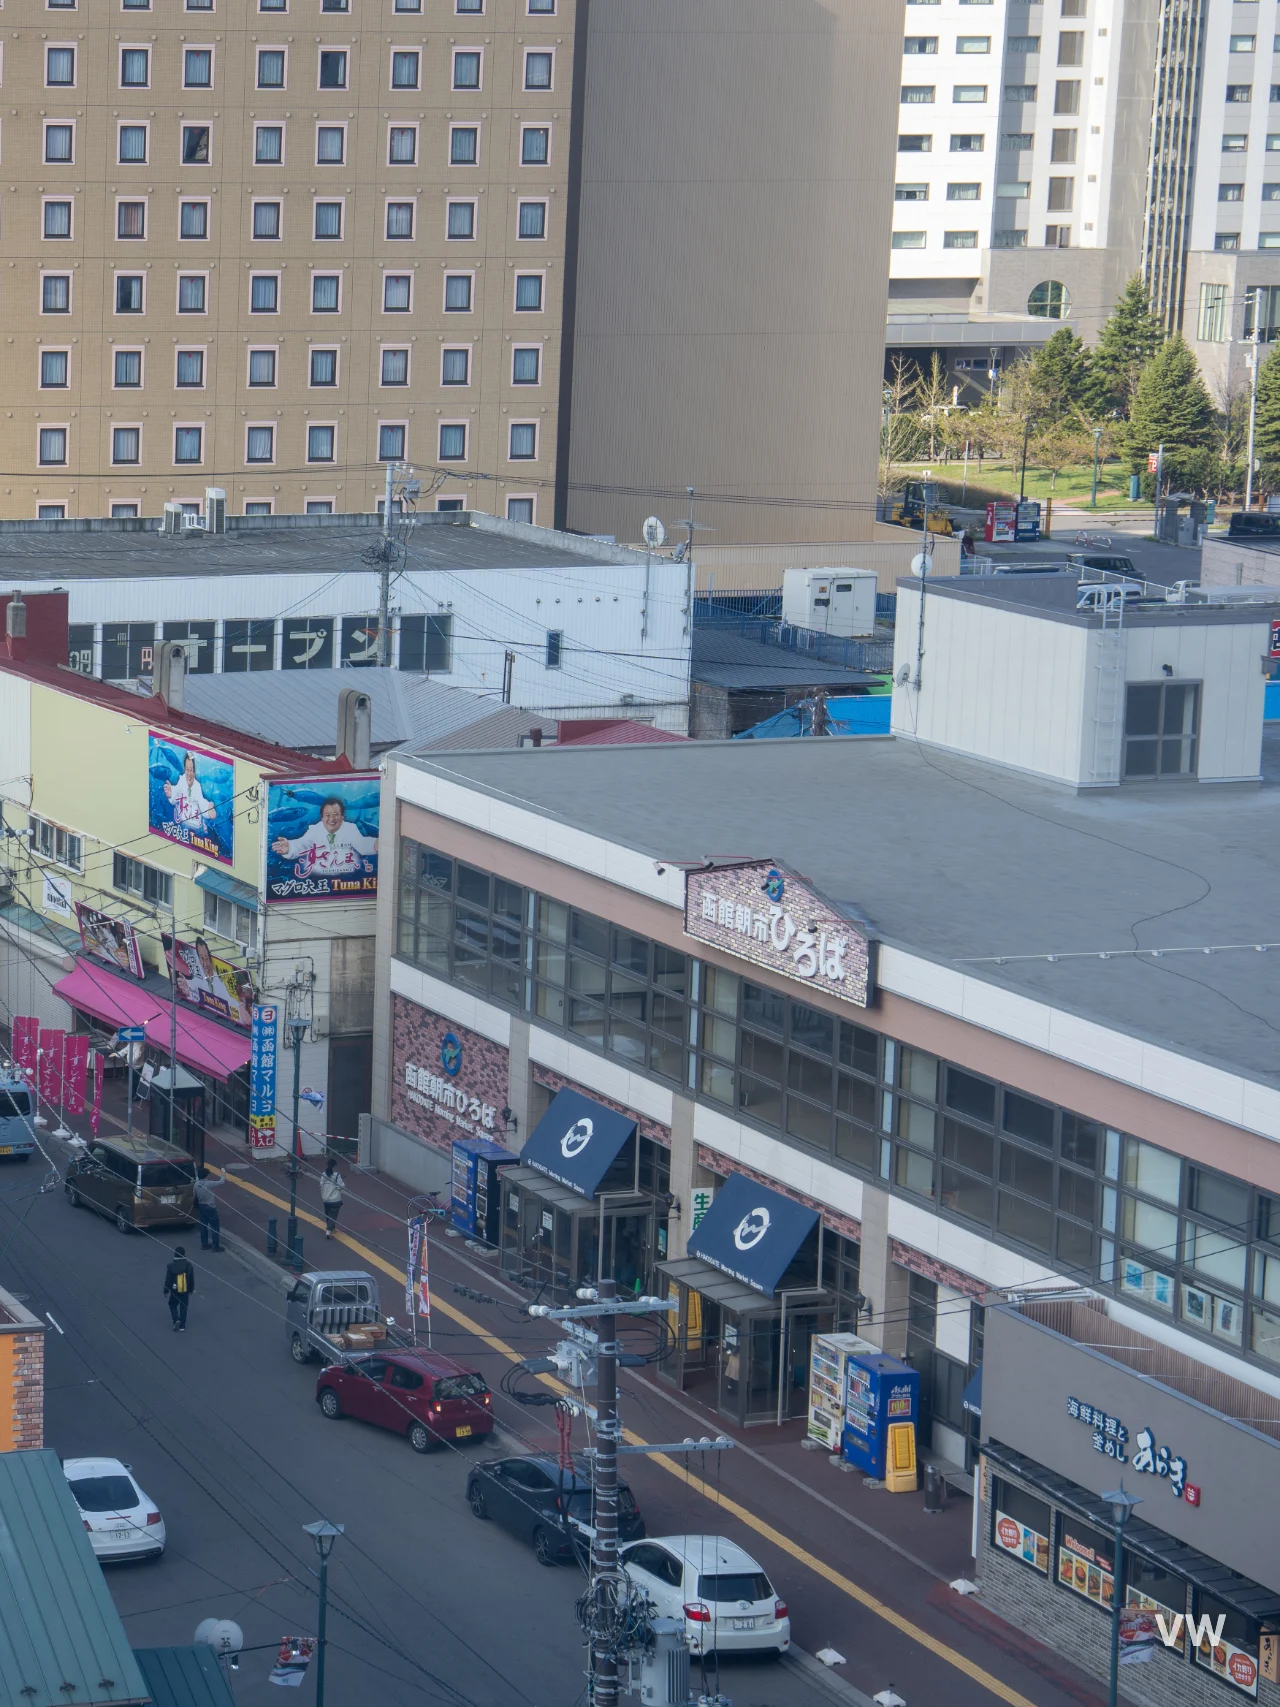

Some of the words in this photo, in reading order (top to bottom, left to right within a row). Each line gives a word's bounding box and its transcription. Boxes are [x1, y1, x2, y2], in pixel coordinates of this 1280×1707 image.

[190, 831, 205, 849] Tuna
[204, 838, 219, 857] King
[272, 878, 330, 896] マグロ大王
[332, 878, 360, 891] Tuna
[362, 876, 378, 891] Ki
[702, 891, 849, 981] 函館朝市ひろば
[405, 1062, 497, 1129] 函館朝市ひろば
[407, 1088, 434, 1112] HAKODATE
[434, 1104, 455, 1123] Morning
[257, 1137, 274, 1147] 入口
[700, 1252, 720, 1268] HAKODATE
[720, 1262, 735, 1277] Morning
[735, 1270, 749, 1284] Market
[749, 1278, 764, 1291] Square
[890, 1384, 912, 1394] Asahi
[1067, 1397, 1127, 1442] 海鮮料理と
[1091, 1432, 1125, 1462] 釜めし
[1232, 1662, 1252, 1675] イカ釣り
